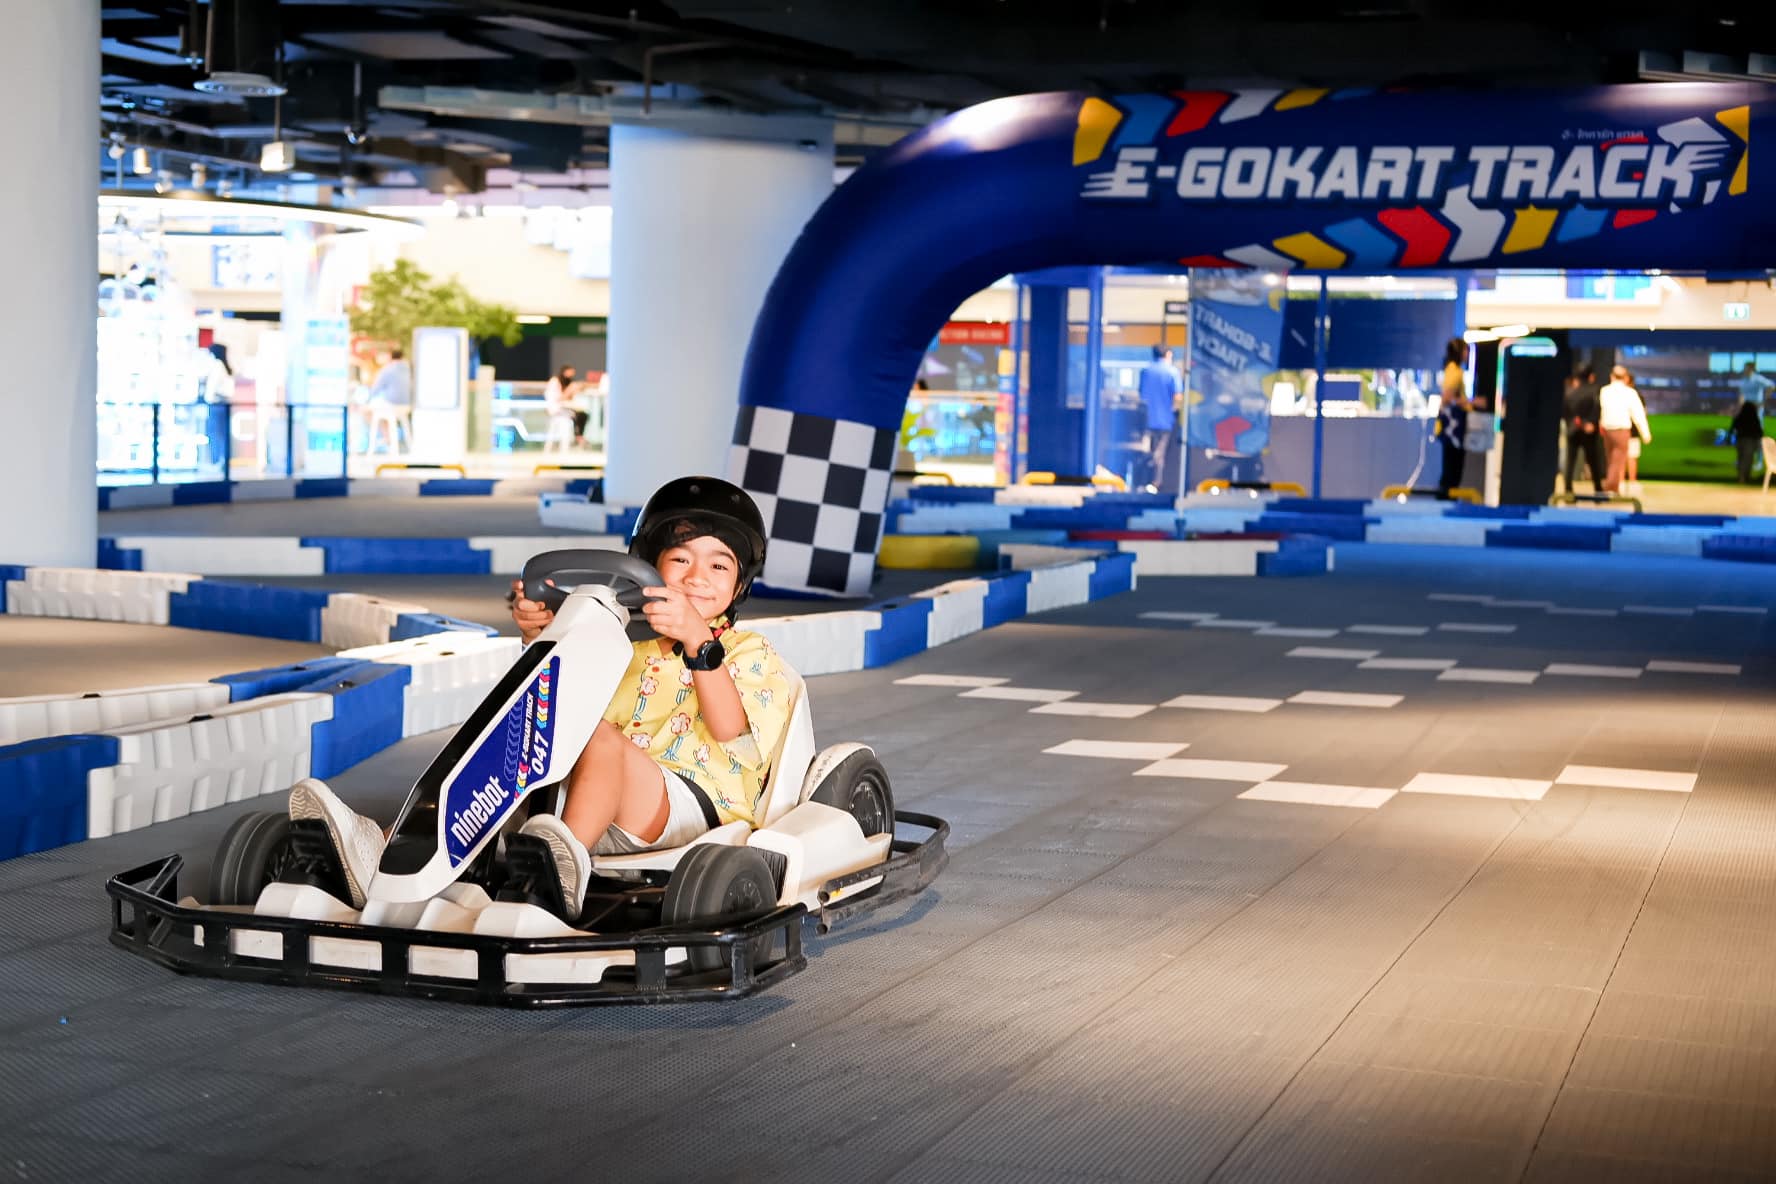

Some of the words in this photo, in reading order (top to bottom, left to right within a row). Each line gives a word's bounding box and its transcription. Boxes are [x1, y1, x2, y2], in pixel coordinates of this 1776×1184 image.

[1080, 147, 1455, 198] E-GOKART
[1468, 146, 1731, 199] TRACK
[531, 730, 549, 775] 047
[450, 775, 509, 848] ninebot
